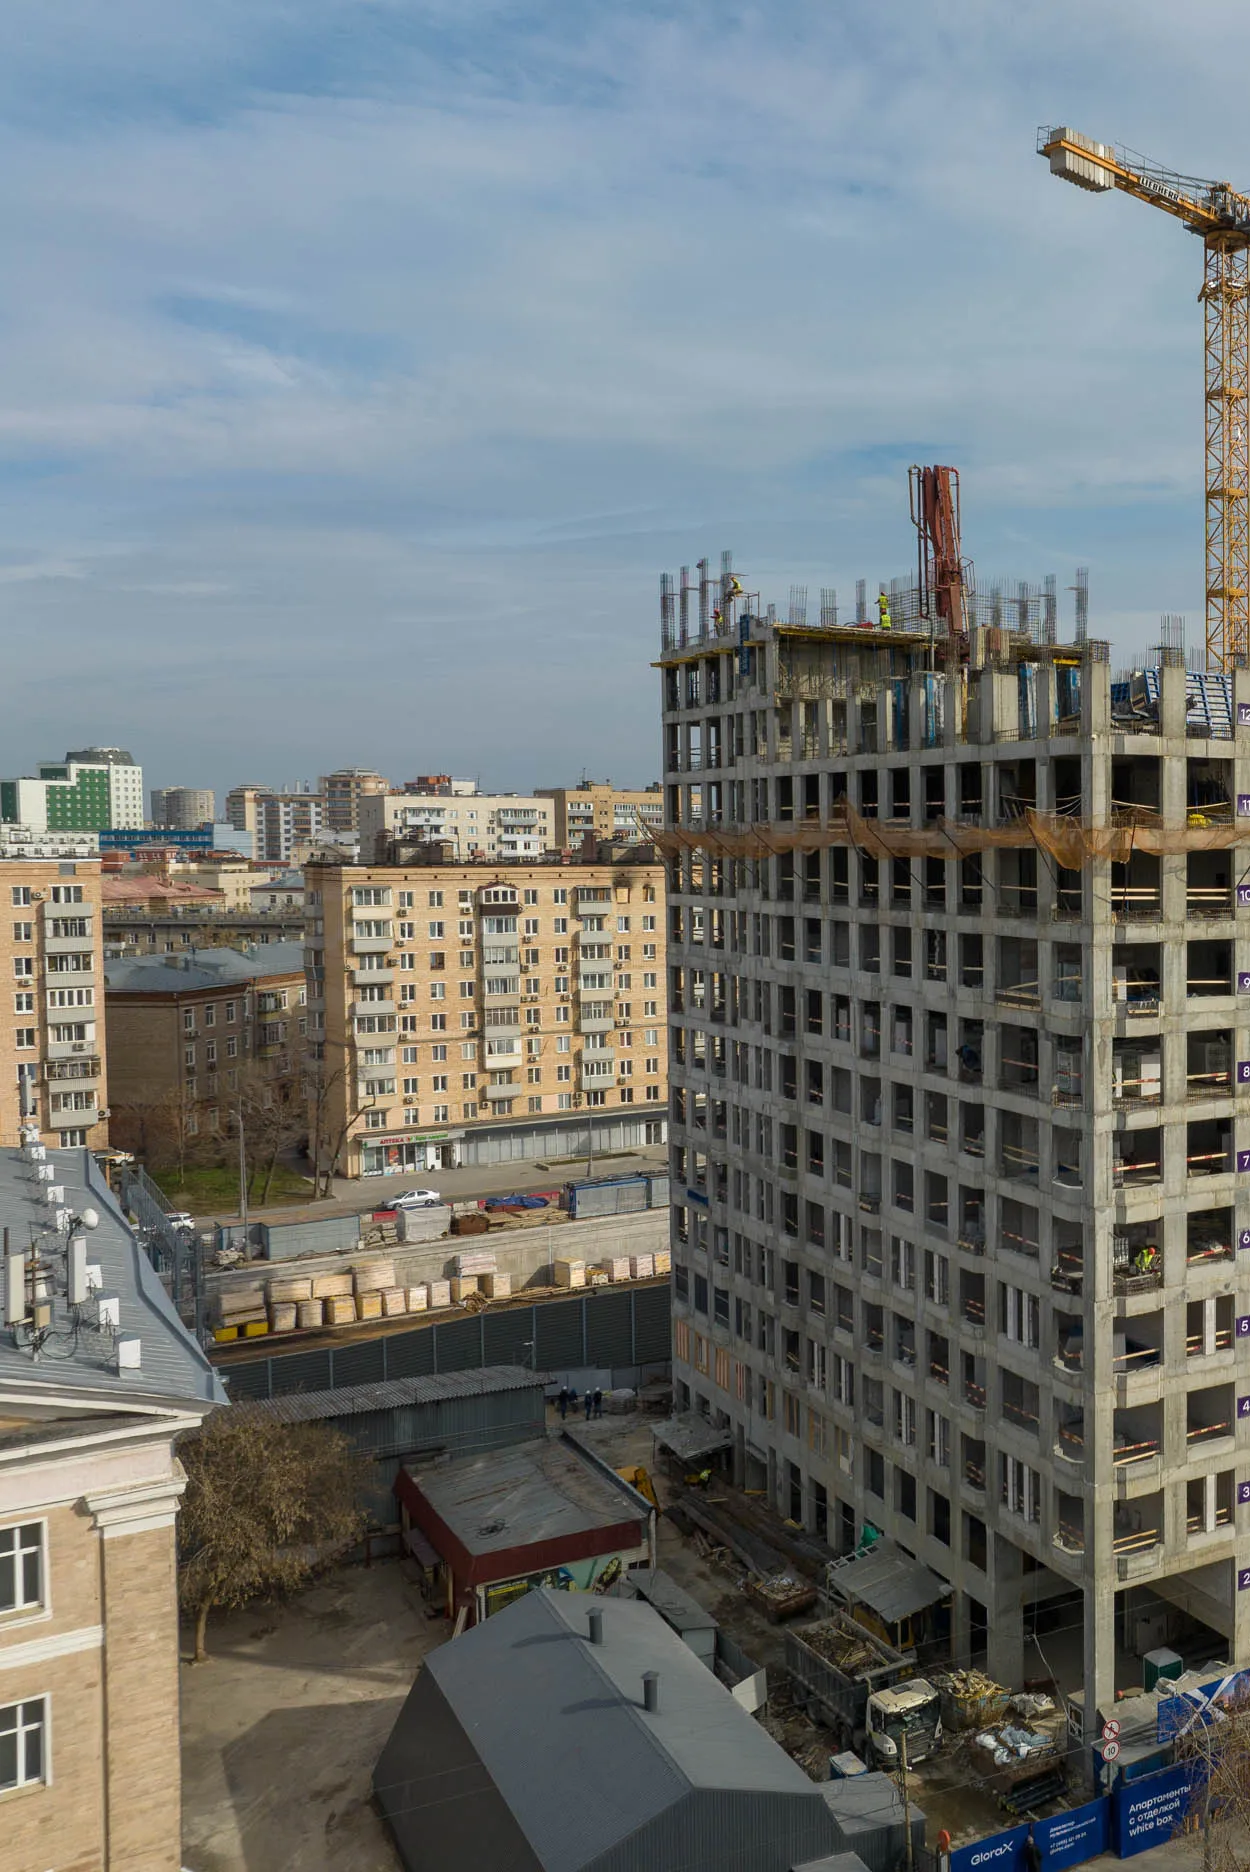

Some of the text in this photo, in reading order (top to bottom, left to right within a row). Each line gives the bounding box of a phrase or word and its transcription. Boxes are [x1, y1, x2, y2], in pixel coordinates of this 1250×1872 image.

[1141, 177, 1178, 201] LIEBHERR
[1243, 978, 1250, 989] 9
[1243, 1066, 1250, 1078] 8
[1242, 1155, 1250, 1167] 7
[1242, 1233, 1250, 1244] 6
[1241, 1320, 1249, 1332] 5
[1242, 1400, 1250, 1412] 4
[1242, 1487, 1250, 1498] 3
[1243, 1573, 1250, 1585] 2
[1108, 1746, 1115, 1755] 10
[1129, 1784, 1191, 1813] Апартаменты
[1129, 1798, 1180, 1825] с отделкой
[1129, 1814, 1173, 1837] white box
[971, 1841, 1013, 1866] GloraX
